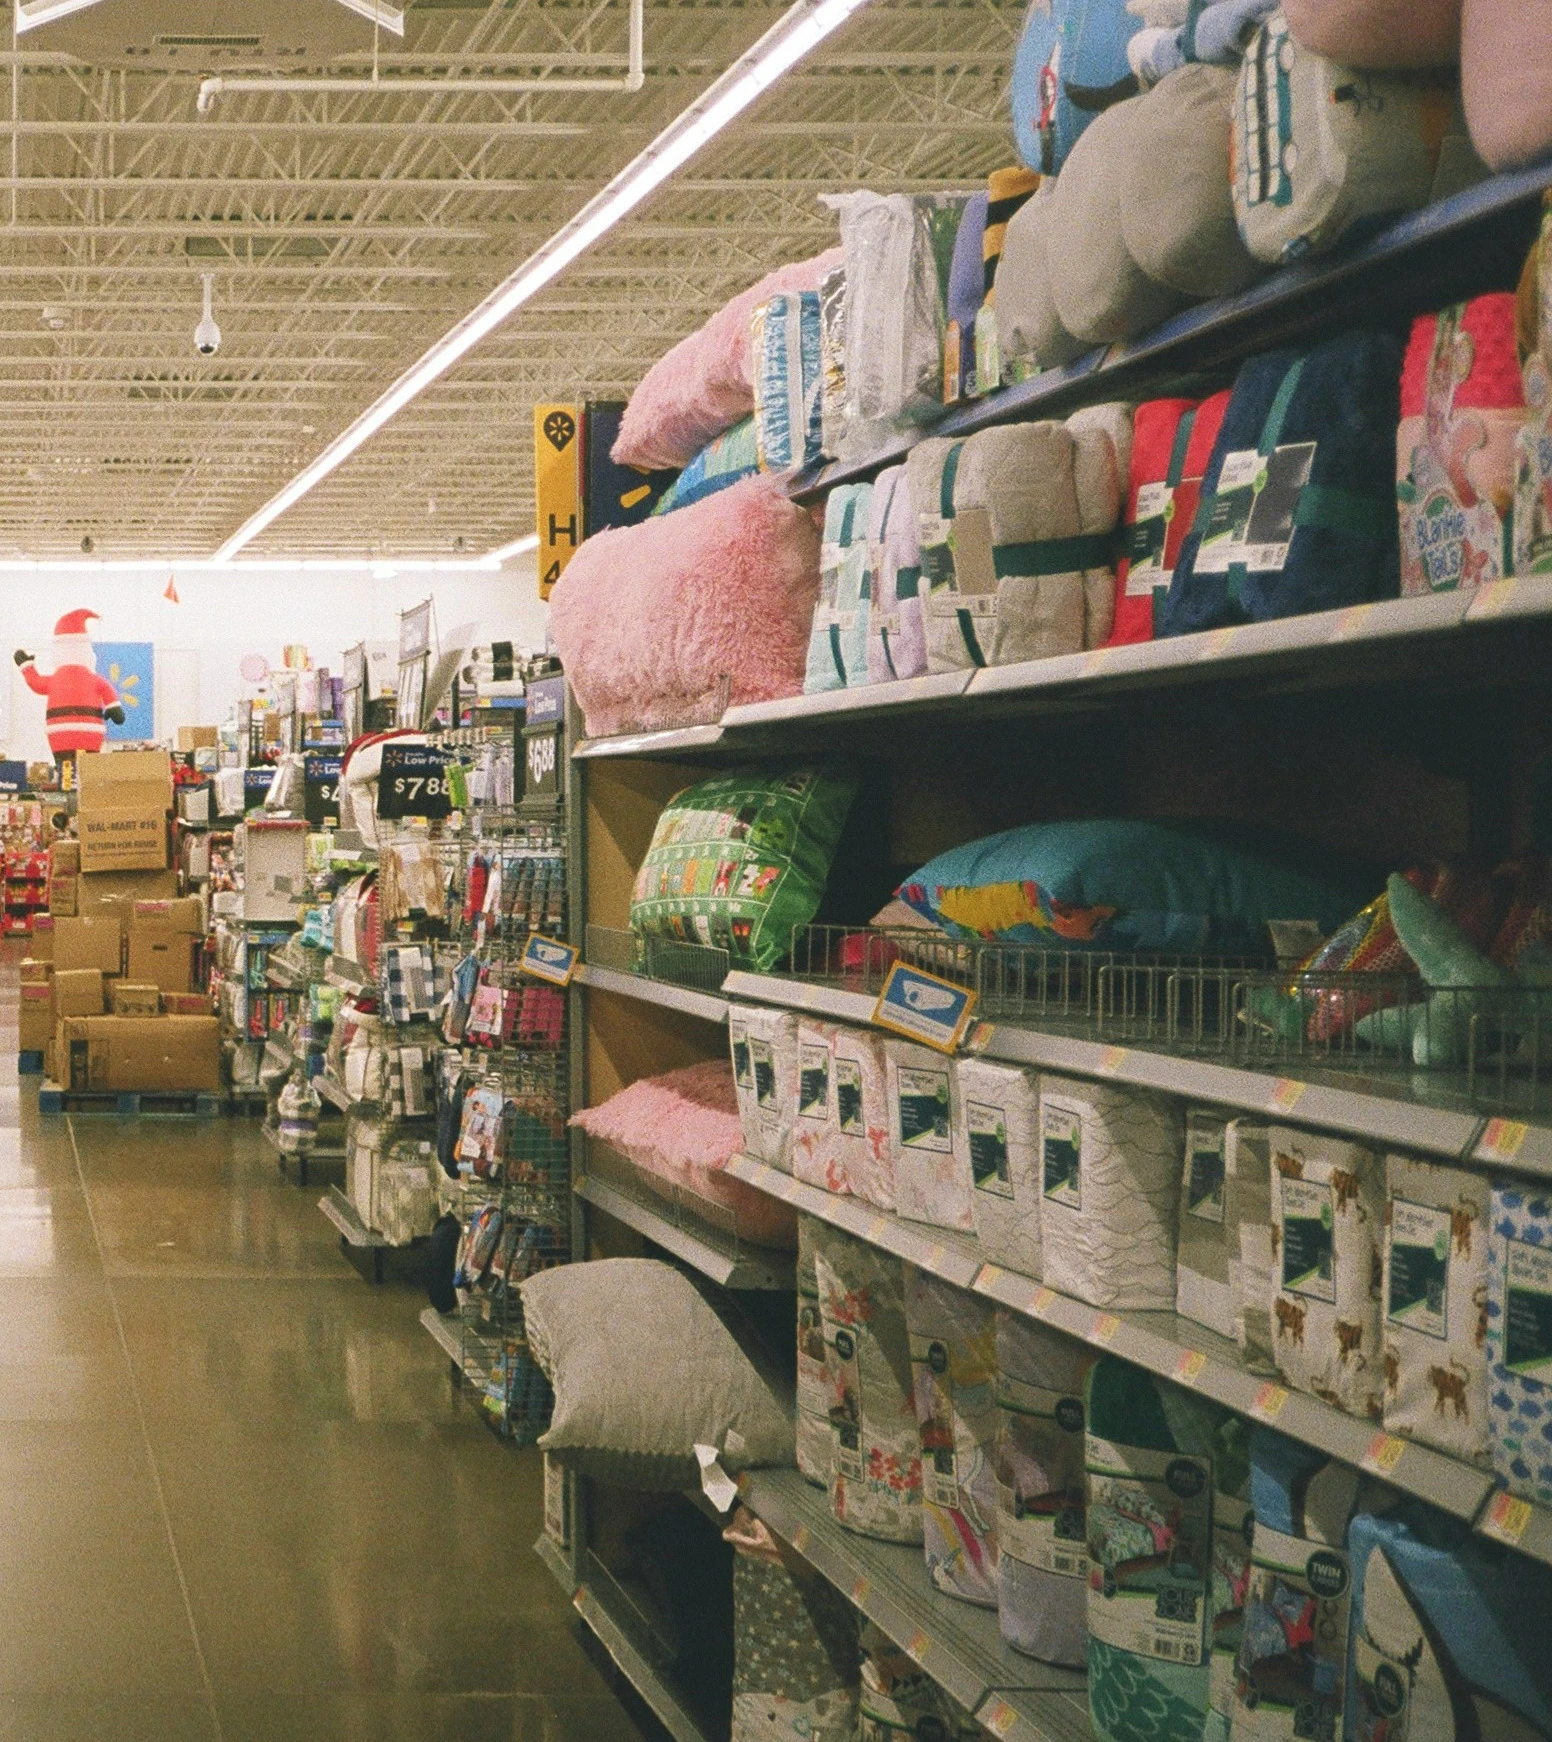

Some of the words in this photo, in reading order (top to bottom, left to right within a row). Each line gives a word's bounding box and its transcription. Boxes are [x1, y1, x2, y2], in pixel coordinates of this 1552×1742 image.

[548, 513, 577, 547] H
[404, 756, 427, 765] Low
[528, 737, 555, 784] $688
[1311, 1562, 1342, 1578] TWIN
